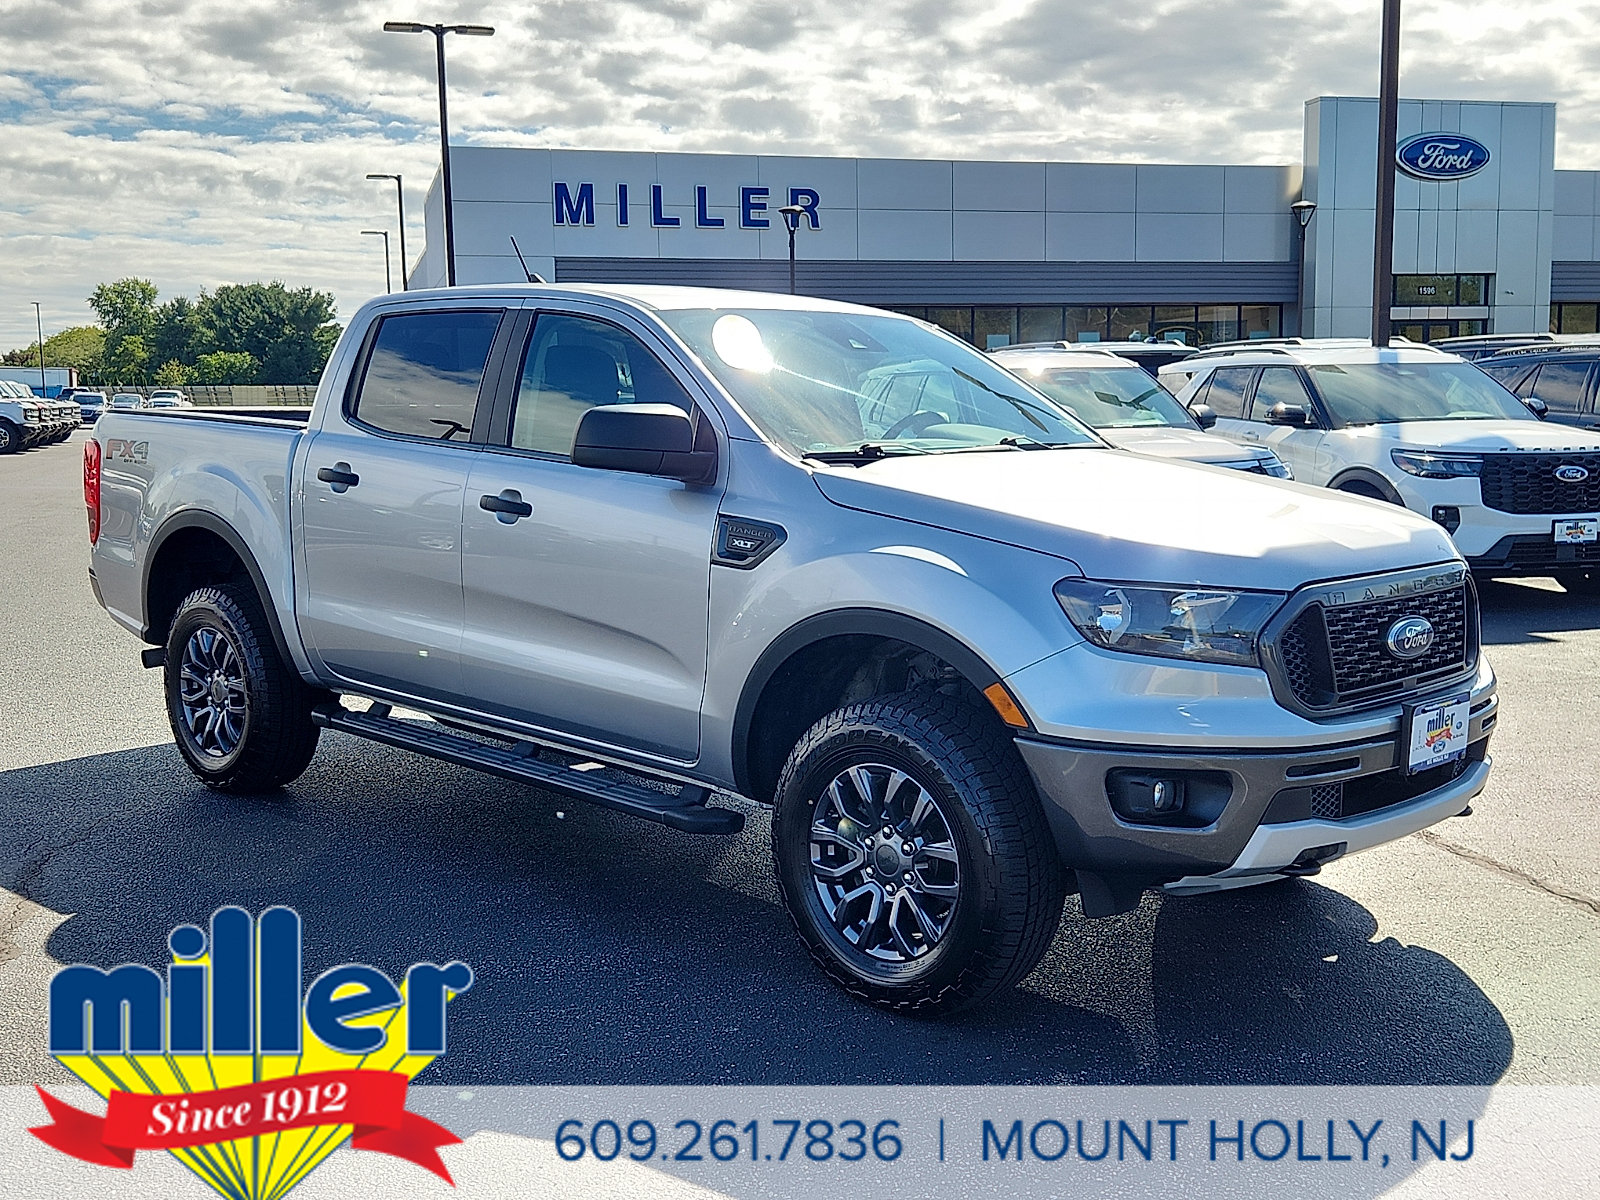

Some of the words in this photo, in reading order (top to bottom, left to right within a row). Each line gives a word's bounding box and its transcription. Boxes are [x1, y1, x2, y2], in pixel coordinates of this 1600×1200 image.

[1417, 142, 1474, 169] Ford
[553, 181, 822, 230] MILLER
[1419, 286, 1436, 295] 1596
[105, 438, 149, 459] FX4
[729, 525, 772, 538] RANGER
[732, 538, 755, 548] XLT
[1403, 625, 1429, 649] Ford
[1426, 706, 1456, 733] miller
